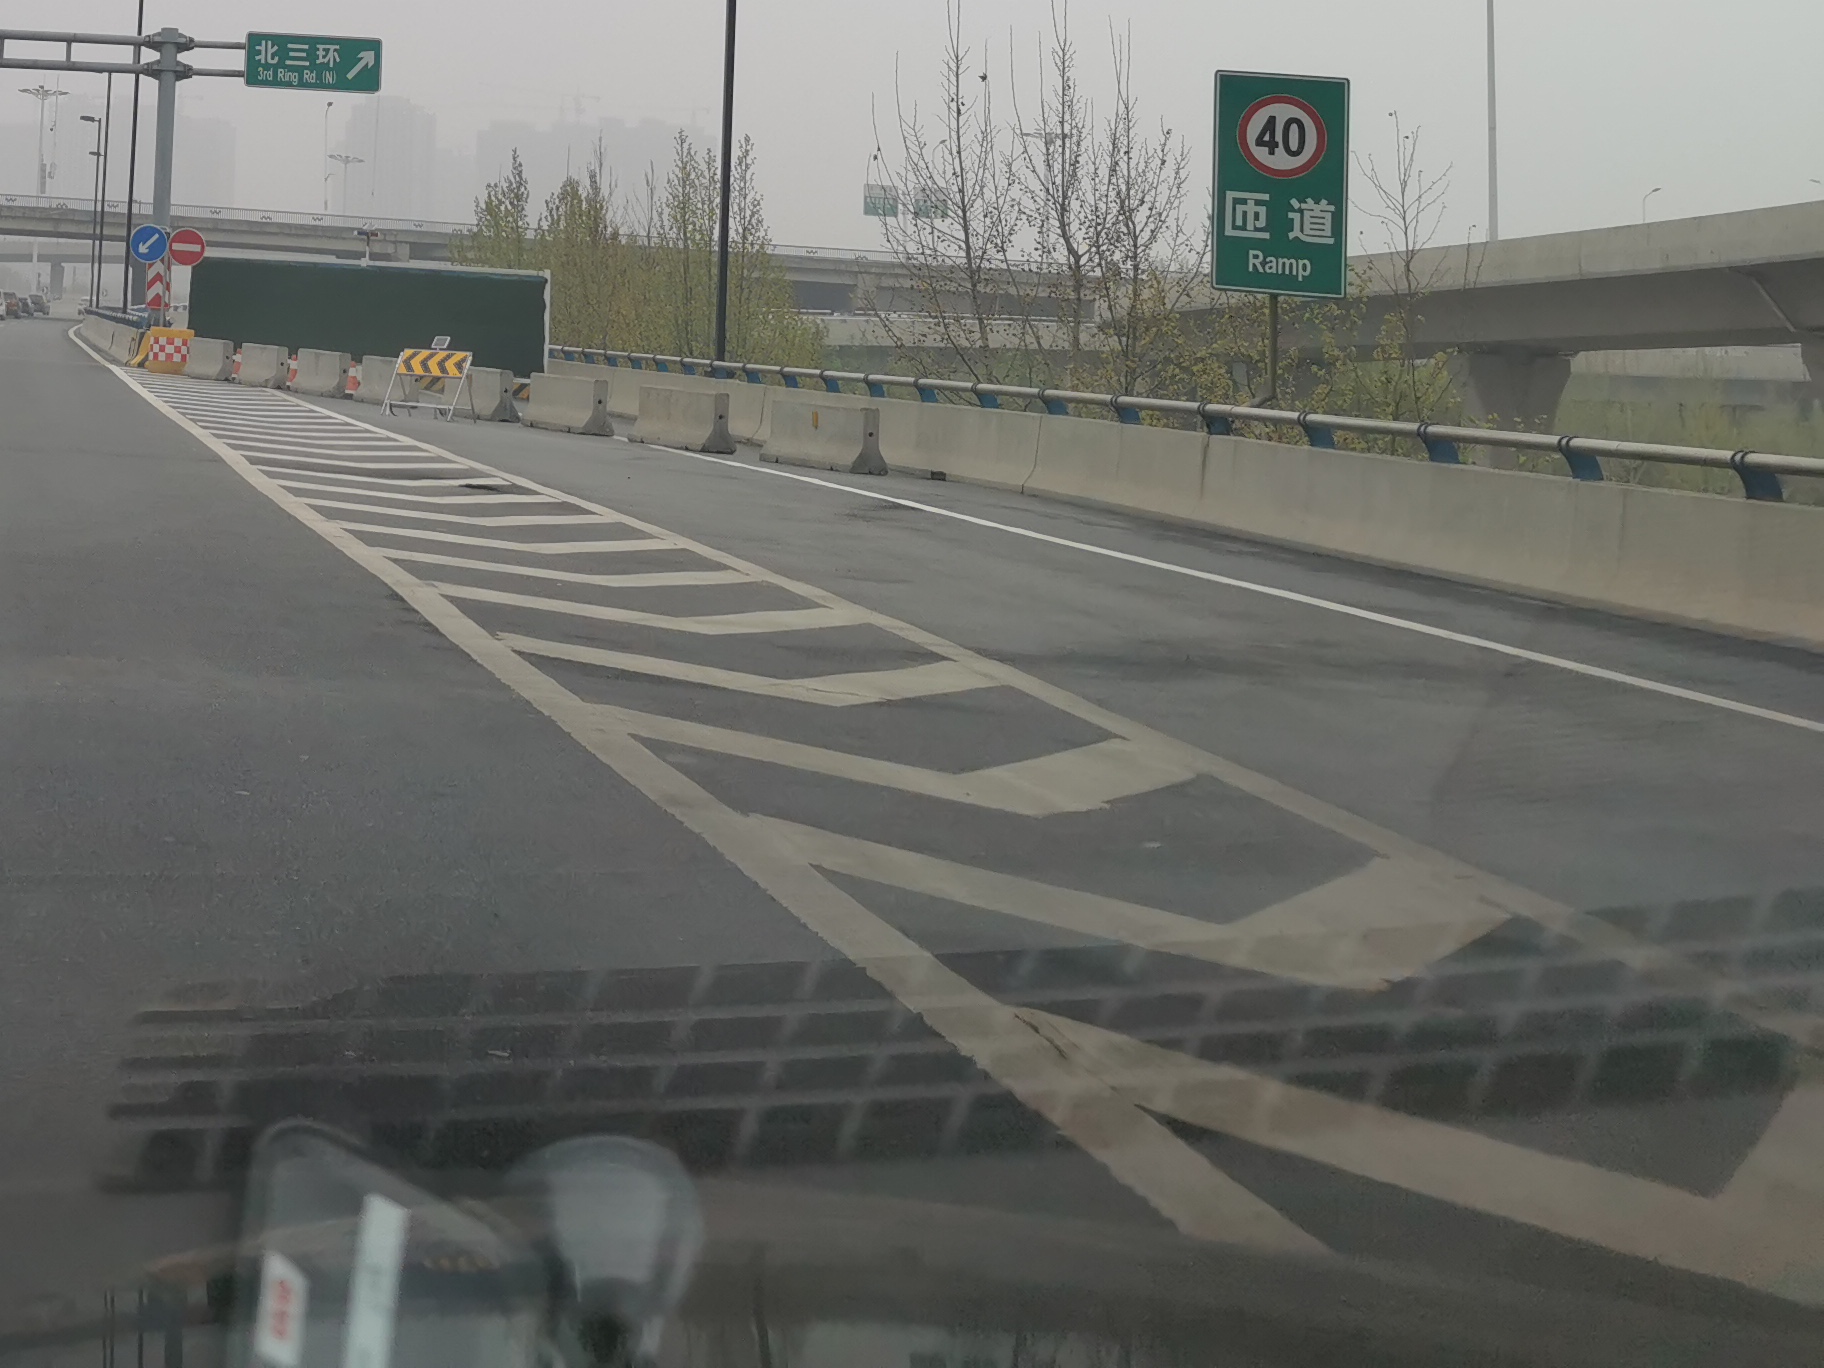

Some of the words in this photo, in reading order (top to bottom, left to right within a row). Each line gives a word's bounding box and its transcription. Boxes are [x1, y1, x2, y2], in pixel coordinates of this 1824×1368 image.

[254, 40, 341, 68] 北三环
[257, 67, 273, 81] 3rd
[277, 68, 299, 85] Ring
[1254, 115, 1307, 158] 40
[1224, 190, 1336, 245] 匝道
[1248, 249, 1312, 282] Ramp
